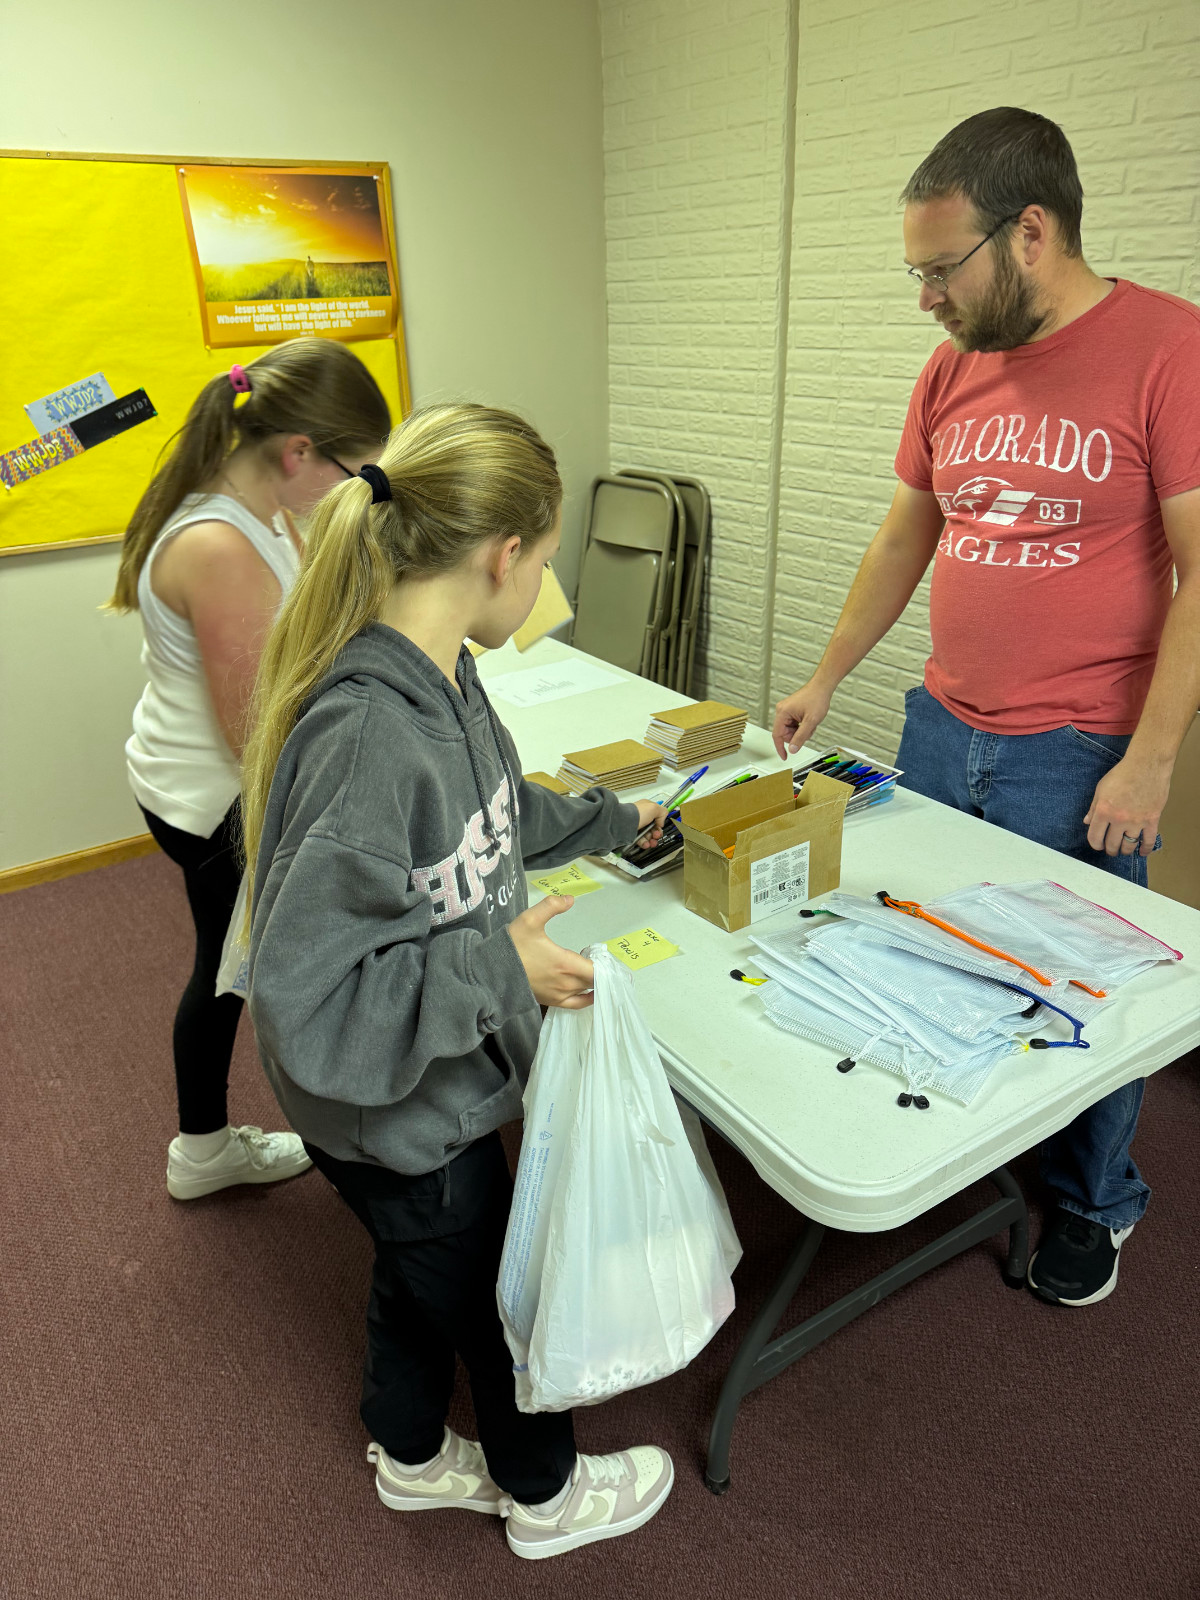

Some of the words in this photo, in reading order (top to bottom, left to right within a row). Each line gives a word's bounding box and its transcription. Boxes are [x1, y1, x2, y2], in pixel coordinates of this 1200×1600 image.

[217, 315, 251, 324] Whoever
[253, 314, 280, 322] follows
[294, 312, 308, 320] will
[309, 312, 328, 320] never
[330, 310, 346, 319] walk
[347, 310, 354, 318] in
[234, 305, 256, 314] Jesus
[285, 304, 296, 312] am
[297, 303, 310, 312] the
[310, 302, 327, 311] light
[328, 301, 335, 310] of
[336, 301, 348, 310] the
[254, 323, 267, 332] but
[268, 322, 282, 331] will
[283, 322, 300, 330] have
[302, 322, 314, 330] the
[314, 320, 331, 330] light
[332, 320, 339, 328] of
[52, 387, 96, 416] WWJD?
[13, 438, 63, 472] WWJD?
[1039, 502, 1065, 521] 03
[938, 531, 1081, 567] AGLES
[644, 928, 660, 942] Take
[617, 938, 640, 960] Pencils
